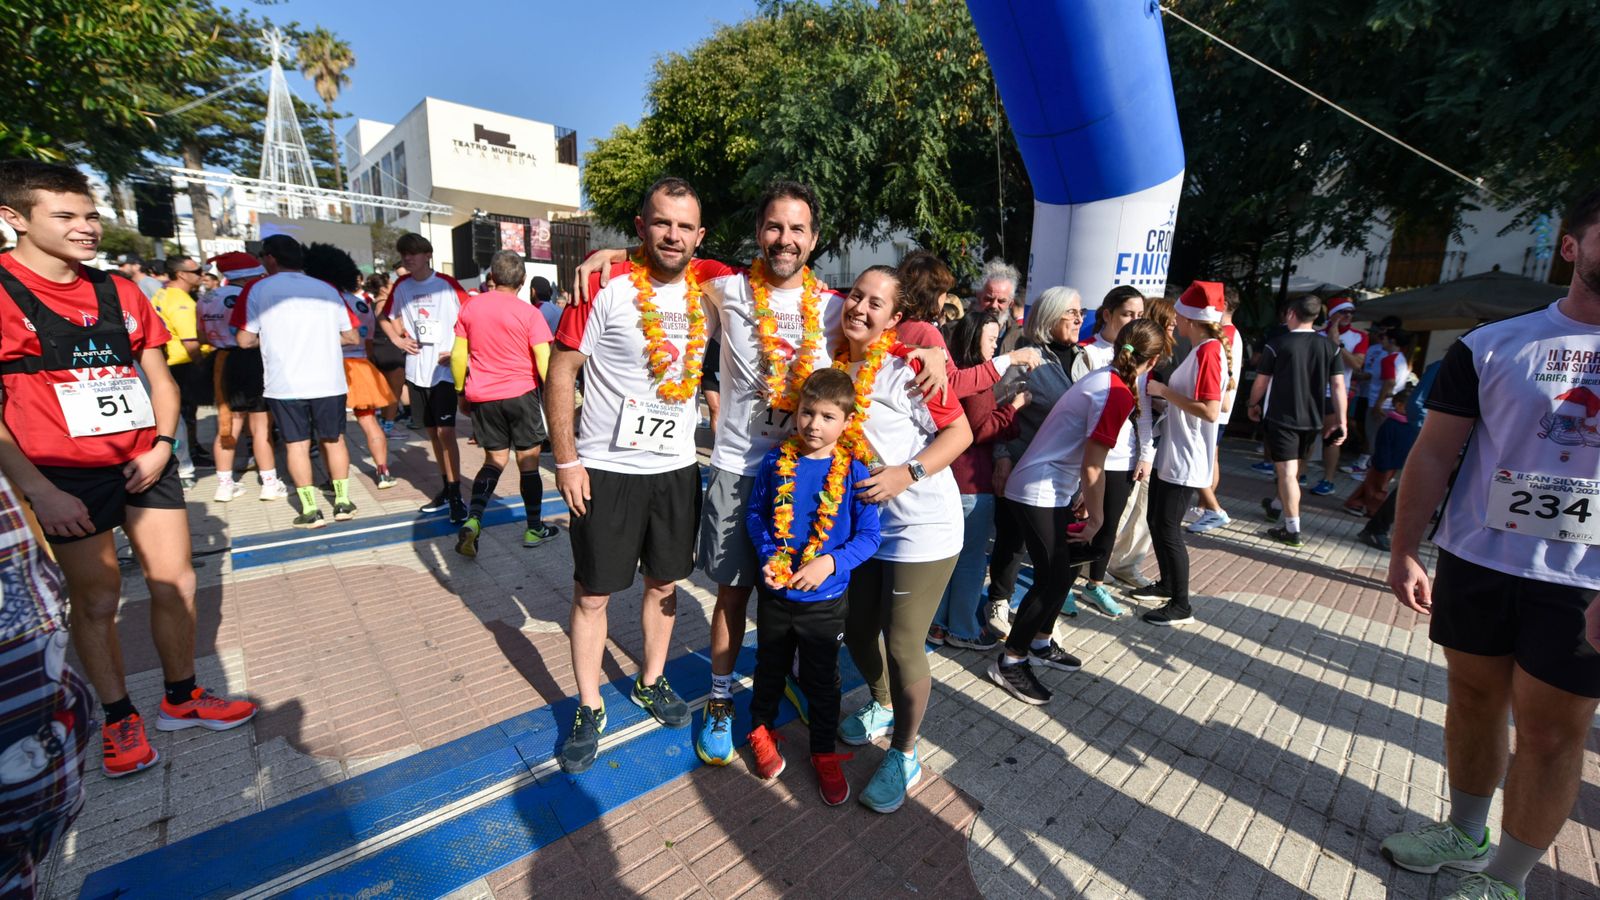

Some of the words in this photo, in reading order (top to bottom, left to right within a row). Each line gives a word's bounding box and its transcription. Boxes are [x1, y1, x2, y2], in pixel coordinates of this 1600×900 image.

[452, 139, 488, 151] TEATRO
[491, 147, 537, 160] MUNICIPAL
[453, 147, 537, 167] ALAMEDA
[1114, 253, 1169, 285] FINIS
[73, 349, 113, 357] RUNITUDE
[1548, 349, 1558, 361] II
[1546, 361, 1569, 371] SAN
[97, 394, 132, 416] 51
[635, 416, 675, 438] 172
[764, 407, 798, 431] 17
[1525, 474, 1551, 483] SAN
[1508, 491, 1592, 523] 234
